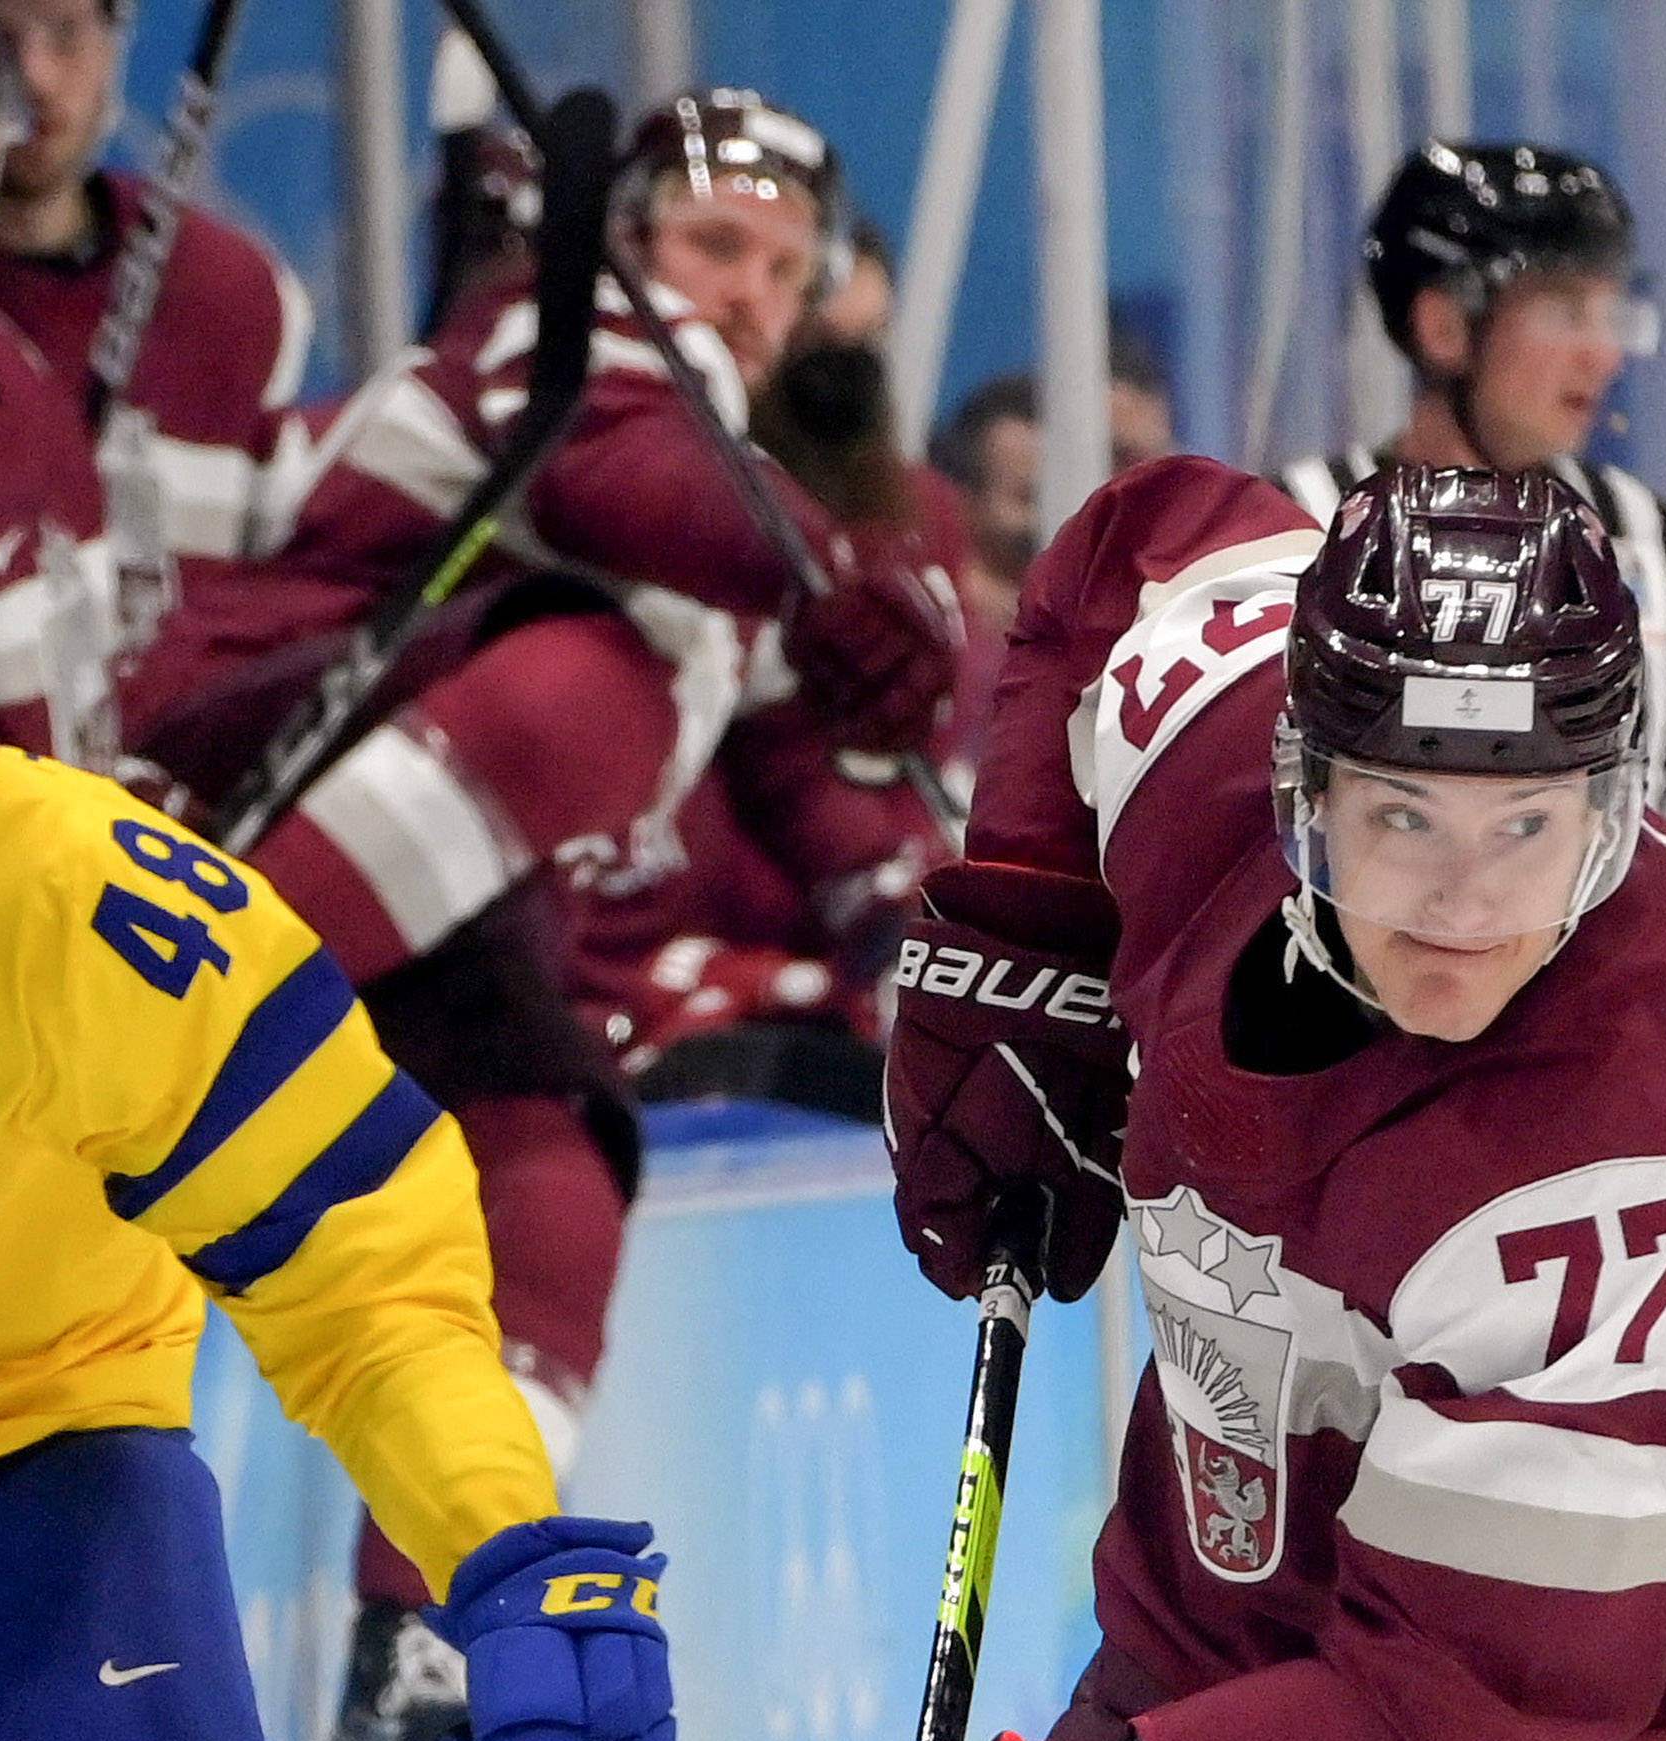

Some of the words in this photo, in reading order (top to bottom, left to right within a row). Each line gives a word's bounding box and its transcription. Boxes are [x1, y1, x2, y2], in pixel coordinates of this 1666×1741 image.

[1419, 578, 1519, 646] 77
[90, 818, 251, 1001] 48
[540, 1572, 659, 1620] CC
